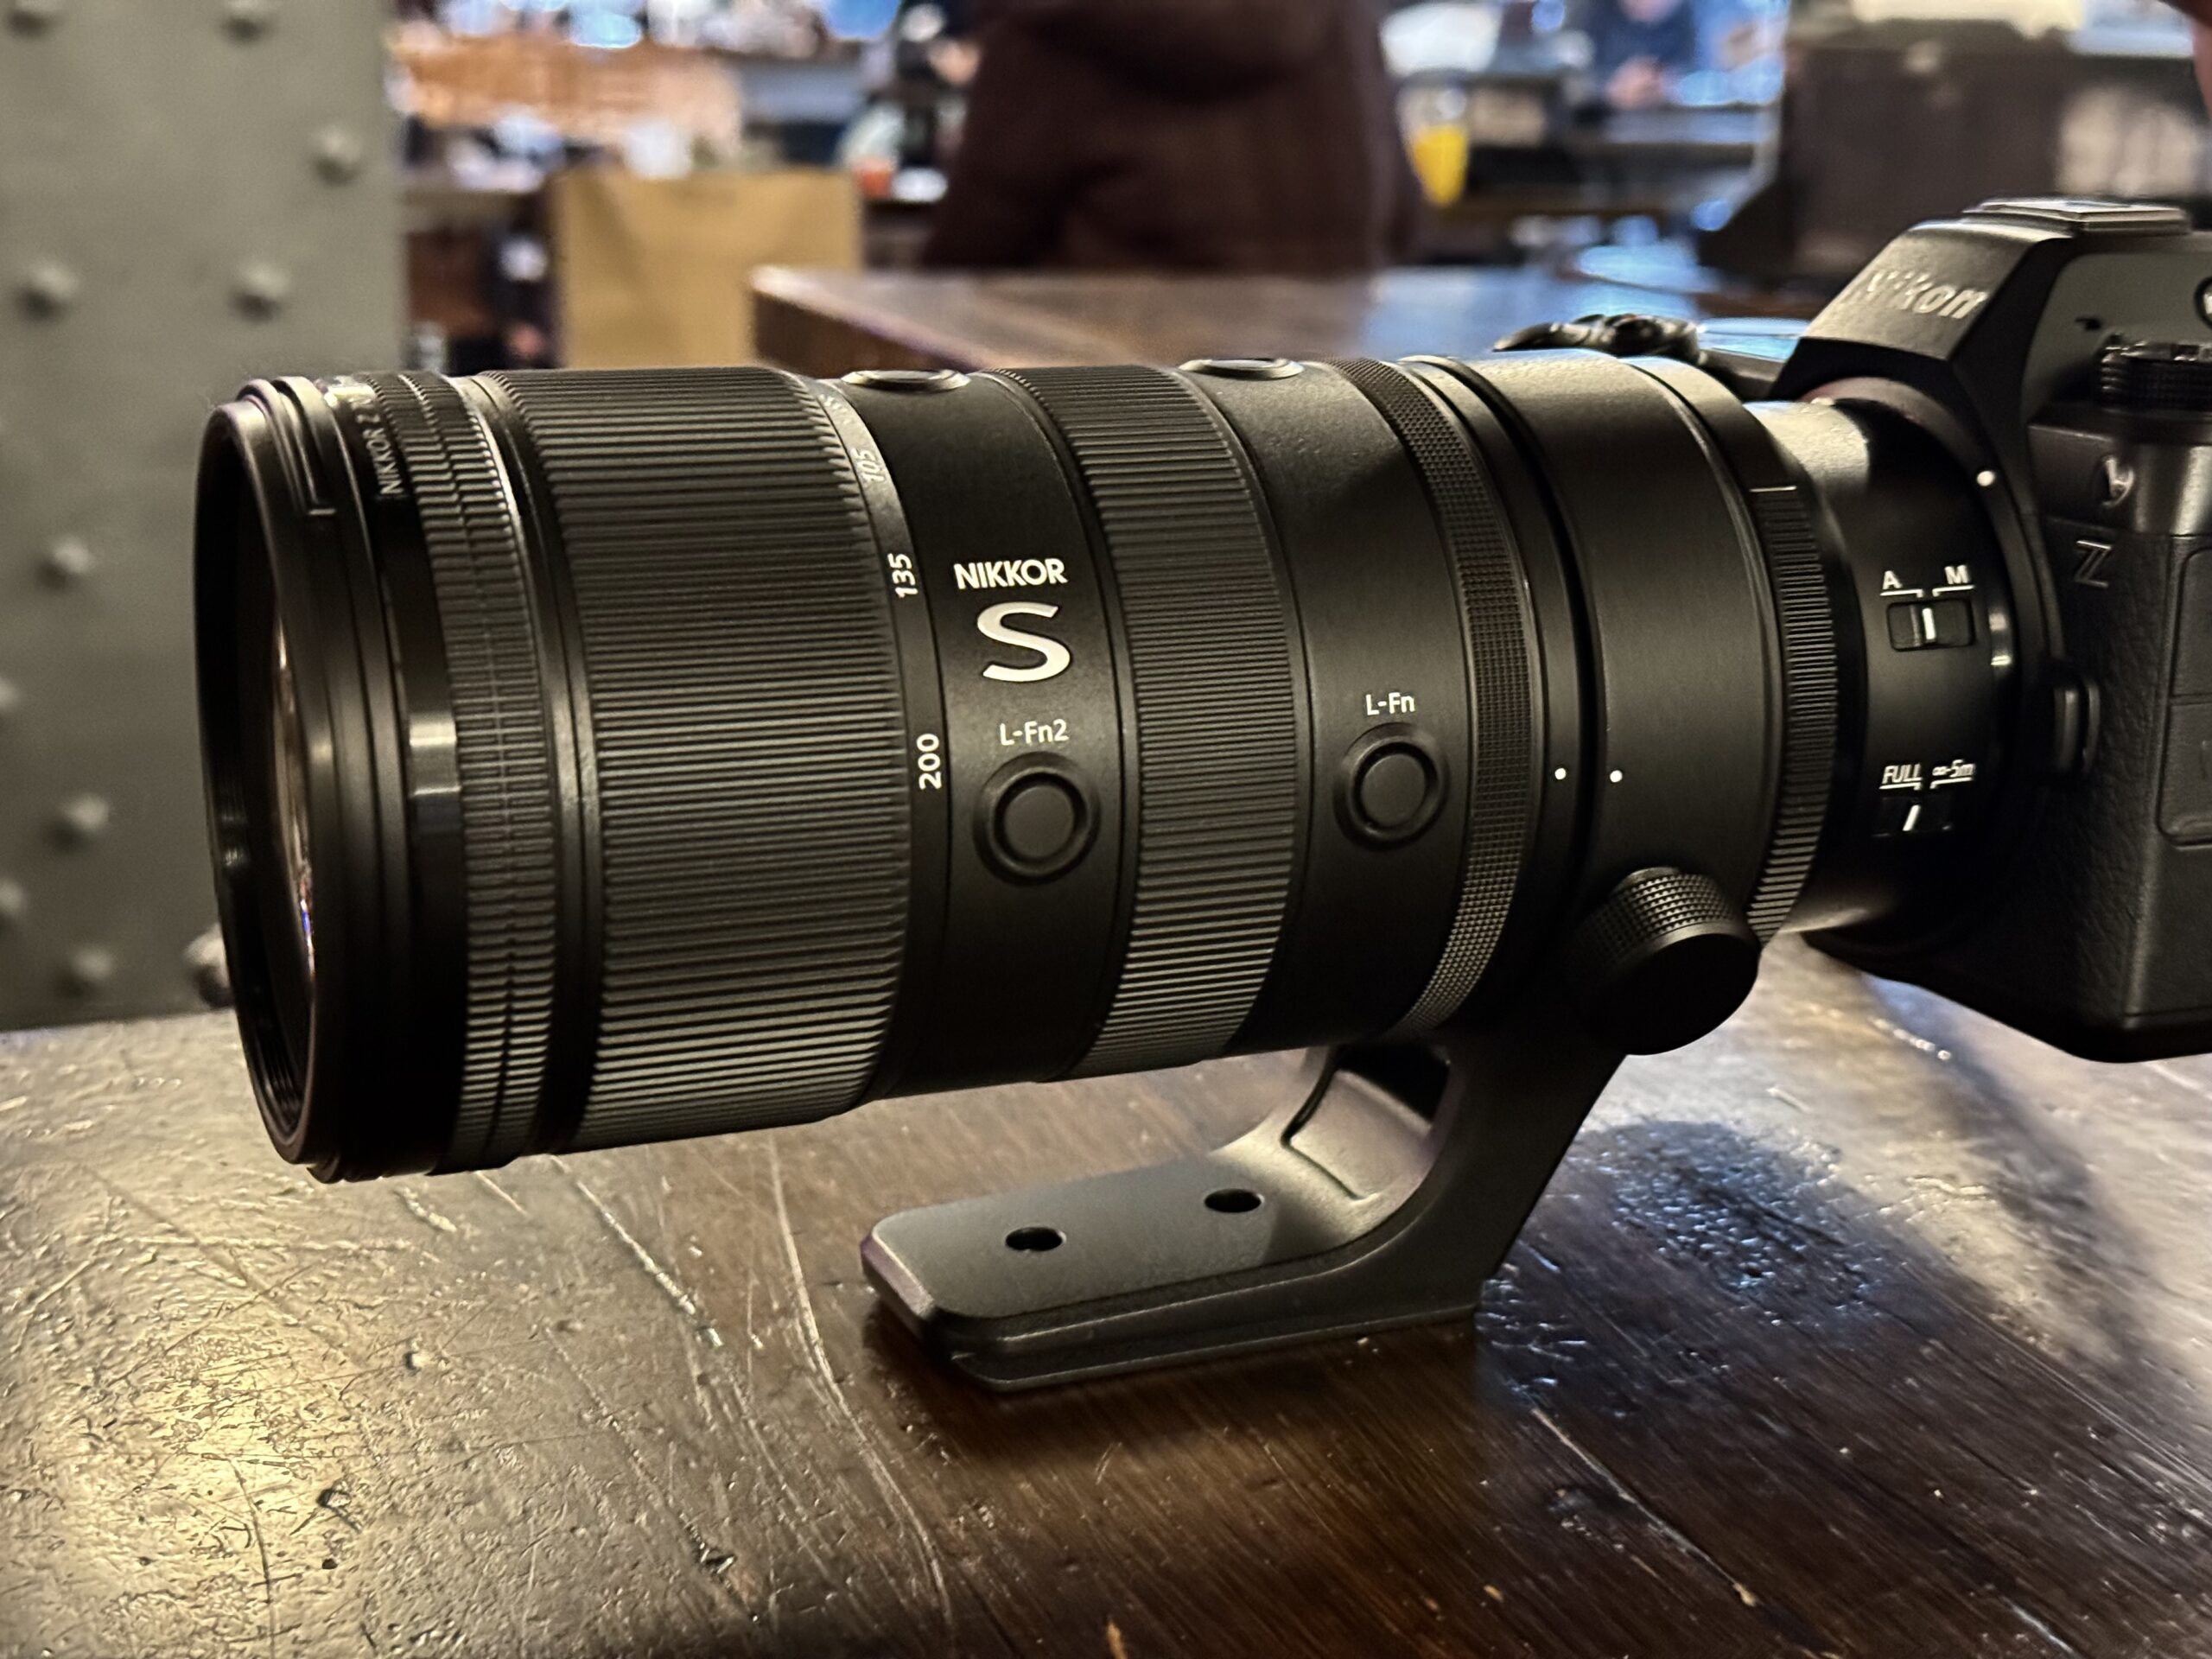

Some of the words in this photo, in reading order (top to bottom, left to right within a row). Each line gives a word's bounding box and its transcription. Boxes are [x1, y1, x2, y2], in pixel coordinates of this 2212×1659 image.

[363, 428, 404, 495] NIKKOR
[887, 553, 918, 598] 135
[953, 558, 1068, 589] NIKKOR
[1882, 570, 1902, 589] A
[1944, 565, 1969, 585] M
[977, 602, 1071, 682] S
[1365, 692, 1415, 715] L-Fn
[1000, 718, 1070, 746] L-Fn2
[917, 734, 942, 790] 200
[1882, 763, 1923, 784] FULL
